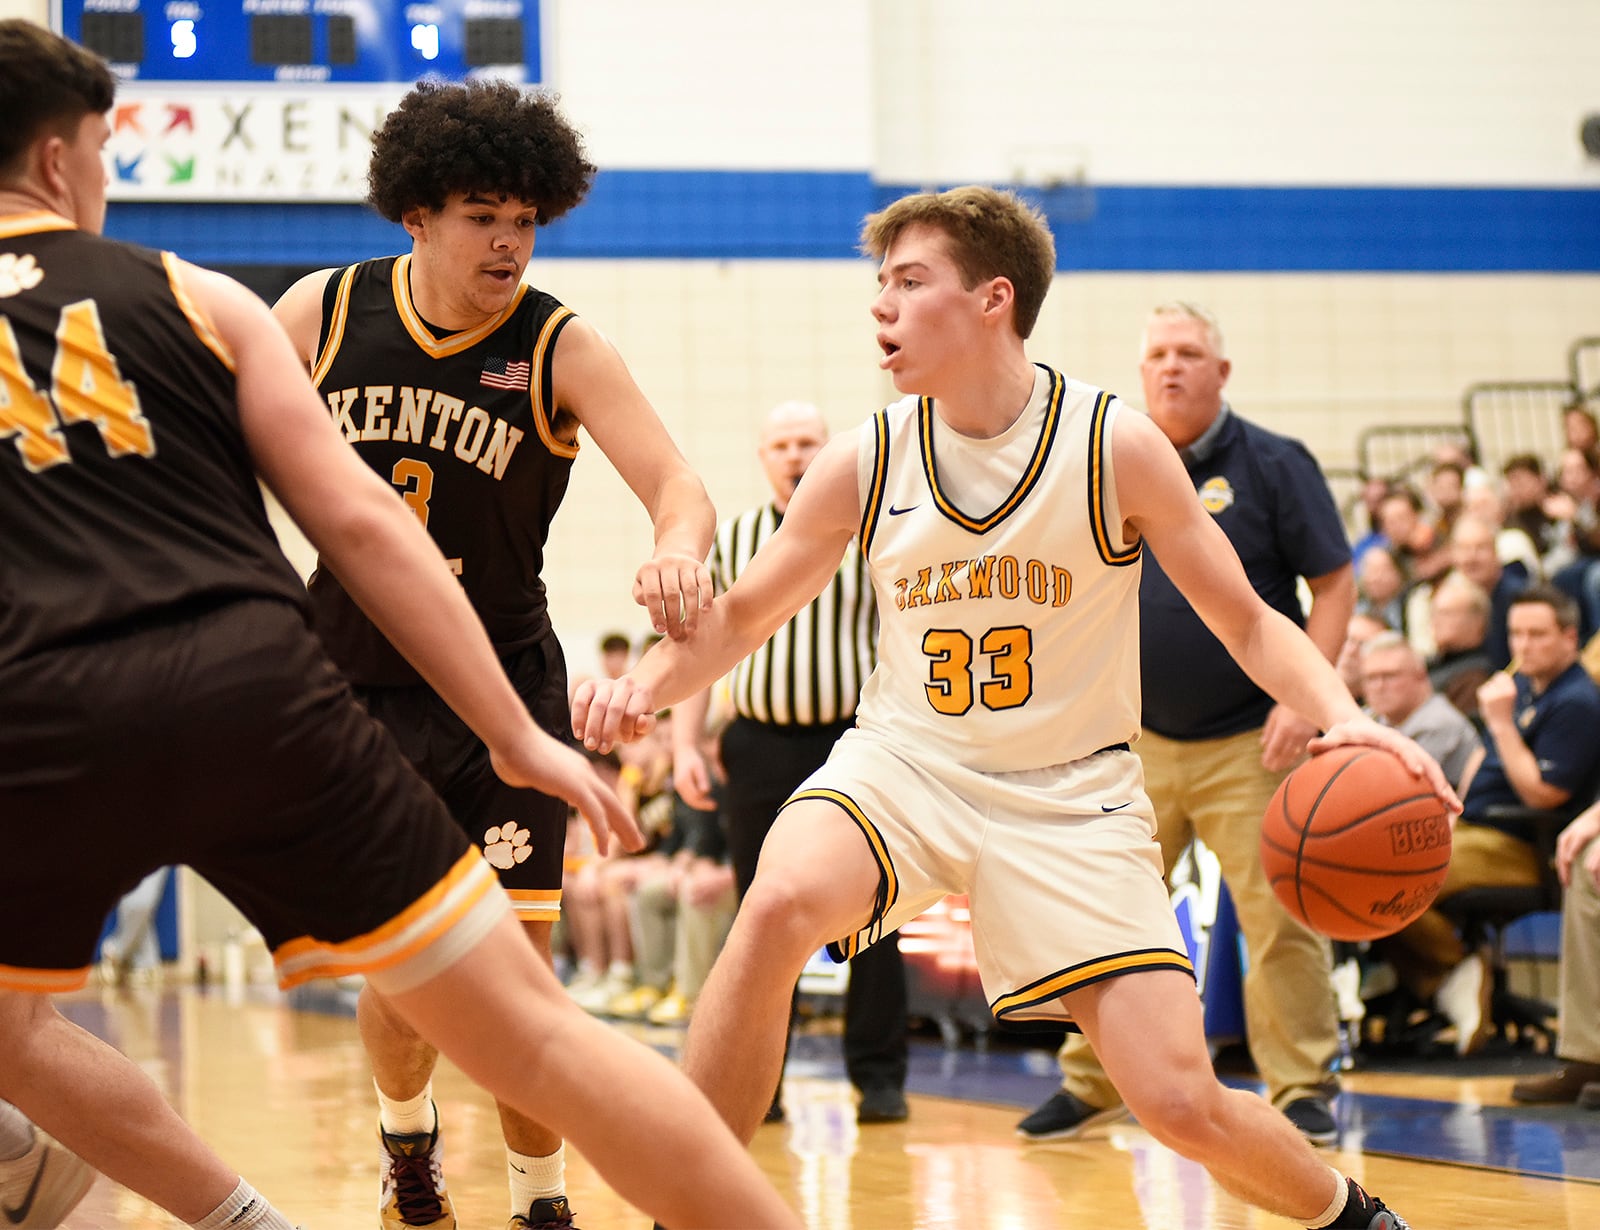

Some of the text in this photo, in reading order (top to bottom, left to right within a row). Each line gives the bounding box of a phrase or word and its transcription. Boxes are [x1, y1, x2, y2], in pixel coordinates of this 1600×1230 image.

[0, 298, 157, 474] 44
[327, 385, 525, 481] KENTON
[392, 457, 434, 530] 3
[894, 555, 1073, 612] OAKWOOD
[921, 625, 1033, 717] 33
